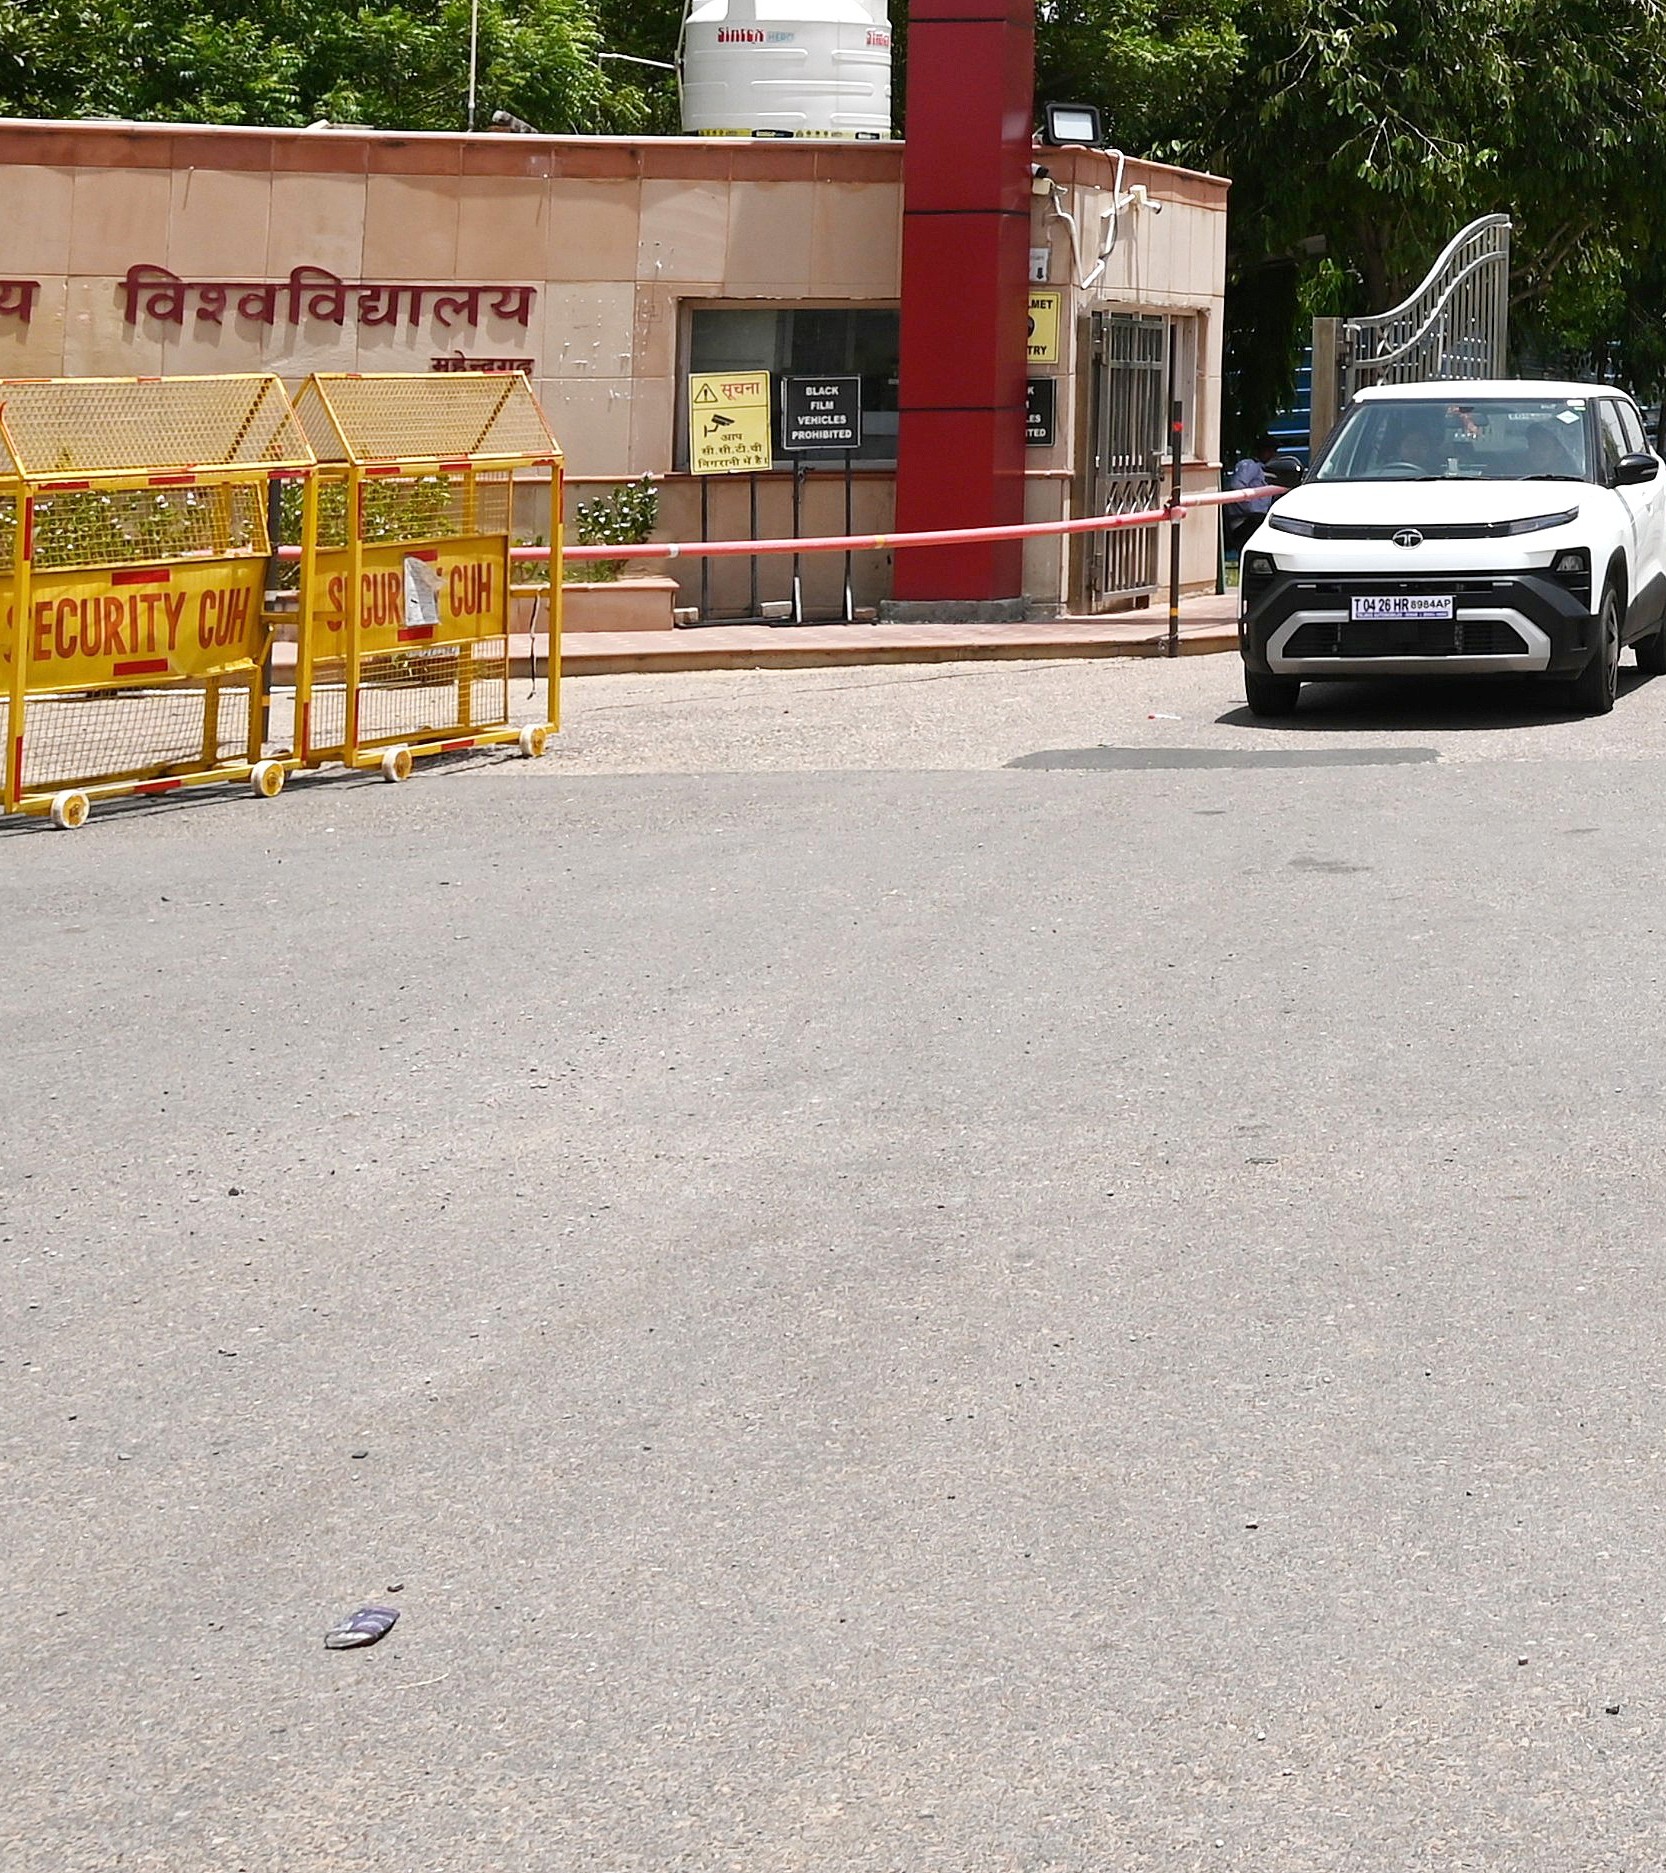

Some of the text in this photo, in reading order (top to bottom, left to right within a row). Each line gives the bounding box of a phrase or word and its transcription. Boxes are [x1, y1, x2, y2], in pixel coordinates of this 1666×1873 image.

[118, 264, 537, 327] विश्वविद्यालय
[720, 382, 760, 400] सूचना
[805, 386, 839, 396] BLACK
[810, 401, 834, 410] FILM
[797, 415, 847, 425] VEHICLES
[720, 433, 743, 442] आप
[791, 429, 852, 440] PROHIBITED
[697, 456, 740, 469] निगरानी
[743, 455, 751, 466] में
[450, 562, 492, 617] CUH
[1354, 598, 1363, 611] T
[1363, 598, 1375, 612] 04
[1379, 598, 1391, 612] 26
[1394, 598, 1409, 611] HR
[199, 587, 251, 649] CUH
